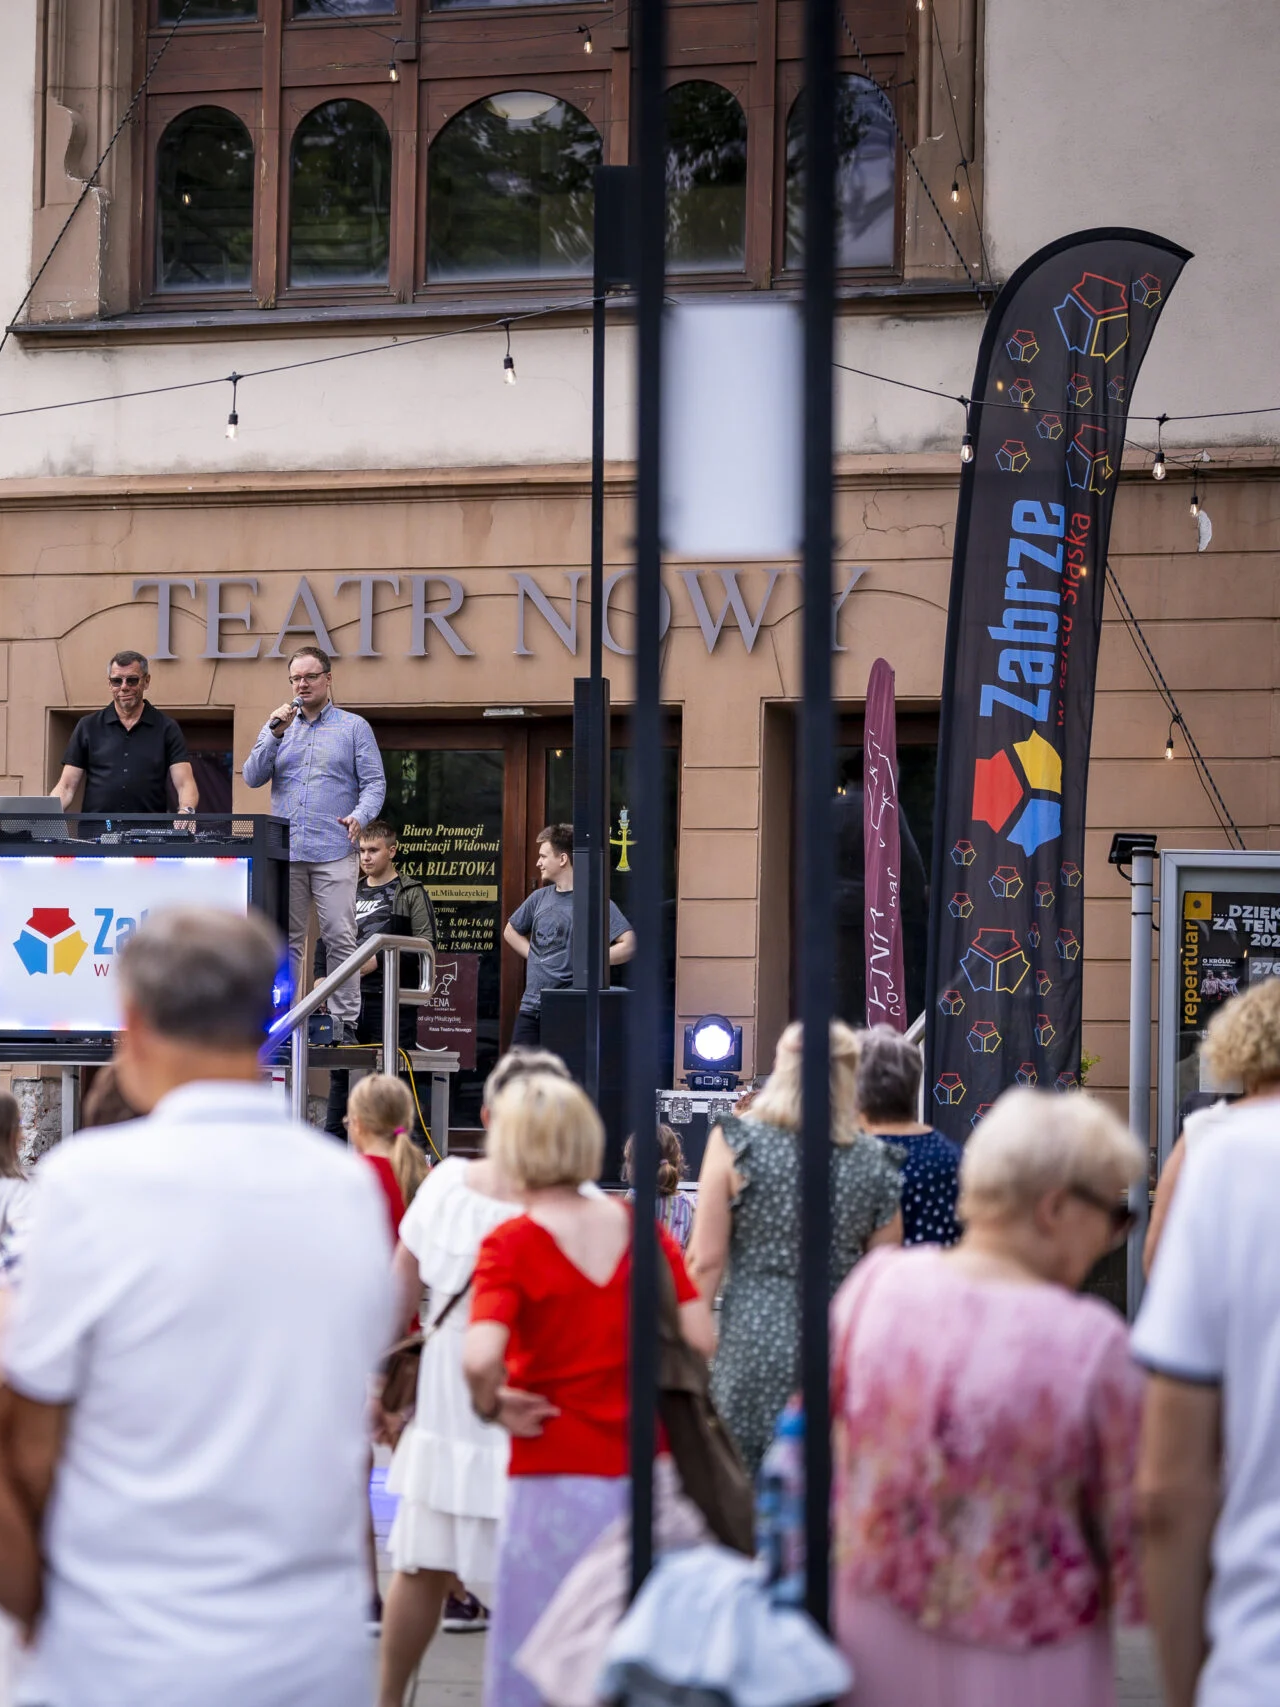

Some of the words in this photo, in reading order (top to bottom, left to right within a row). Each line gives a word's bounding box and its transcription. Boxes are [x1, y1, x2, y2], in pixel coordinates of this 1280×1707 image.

[132, 574, 476, 661] TEATR
[508, 565, 872, 656] NOWY
[979, 499, 1065, 723] Zabrze
[402, 824, 433, 837] Biuro
[435, 824, 484, 839] Promocji
[454, 840, 500, 852] Widowni
[426, 861, 496, 876] BILETOWA
[356, 900, 382, 912] NIKE
[449, 918, 495, 927] 8.00-16.00
[1213, 918, 1238, 931] ZA
[450, 930, 494, 939] 8.00-18.00
[450, 942, 494, 951] 15.00-18.00
[1183, 921, 1202, 1025] repertuar
